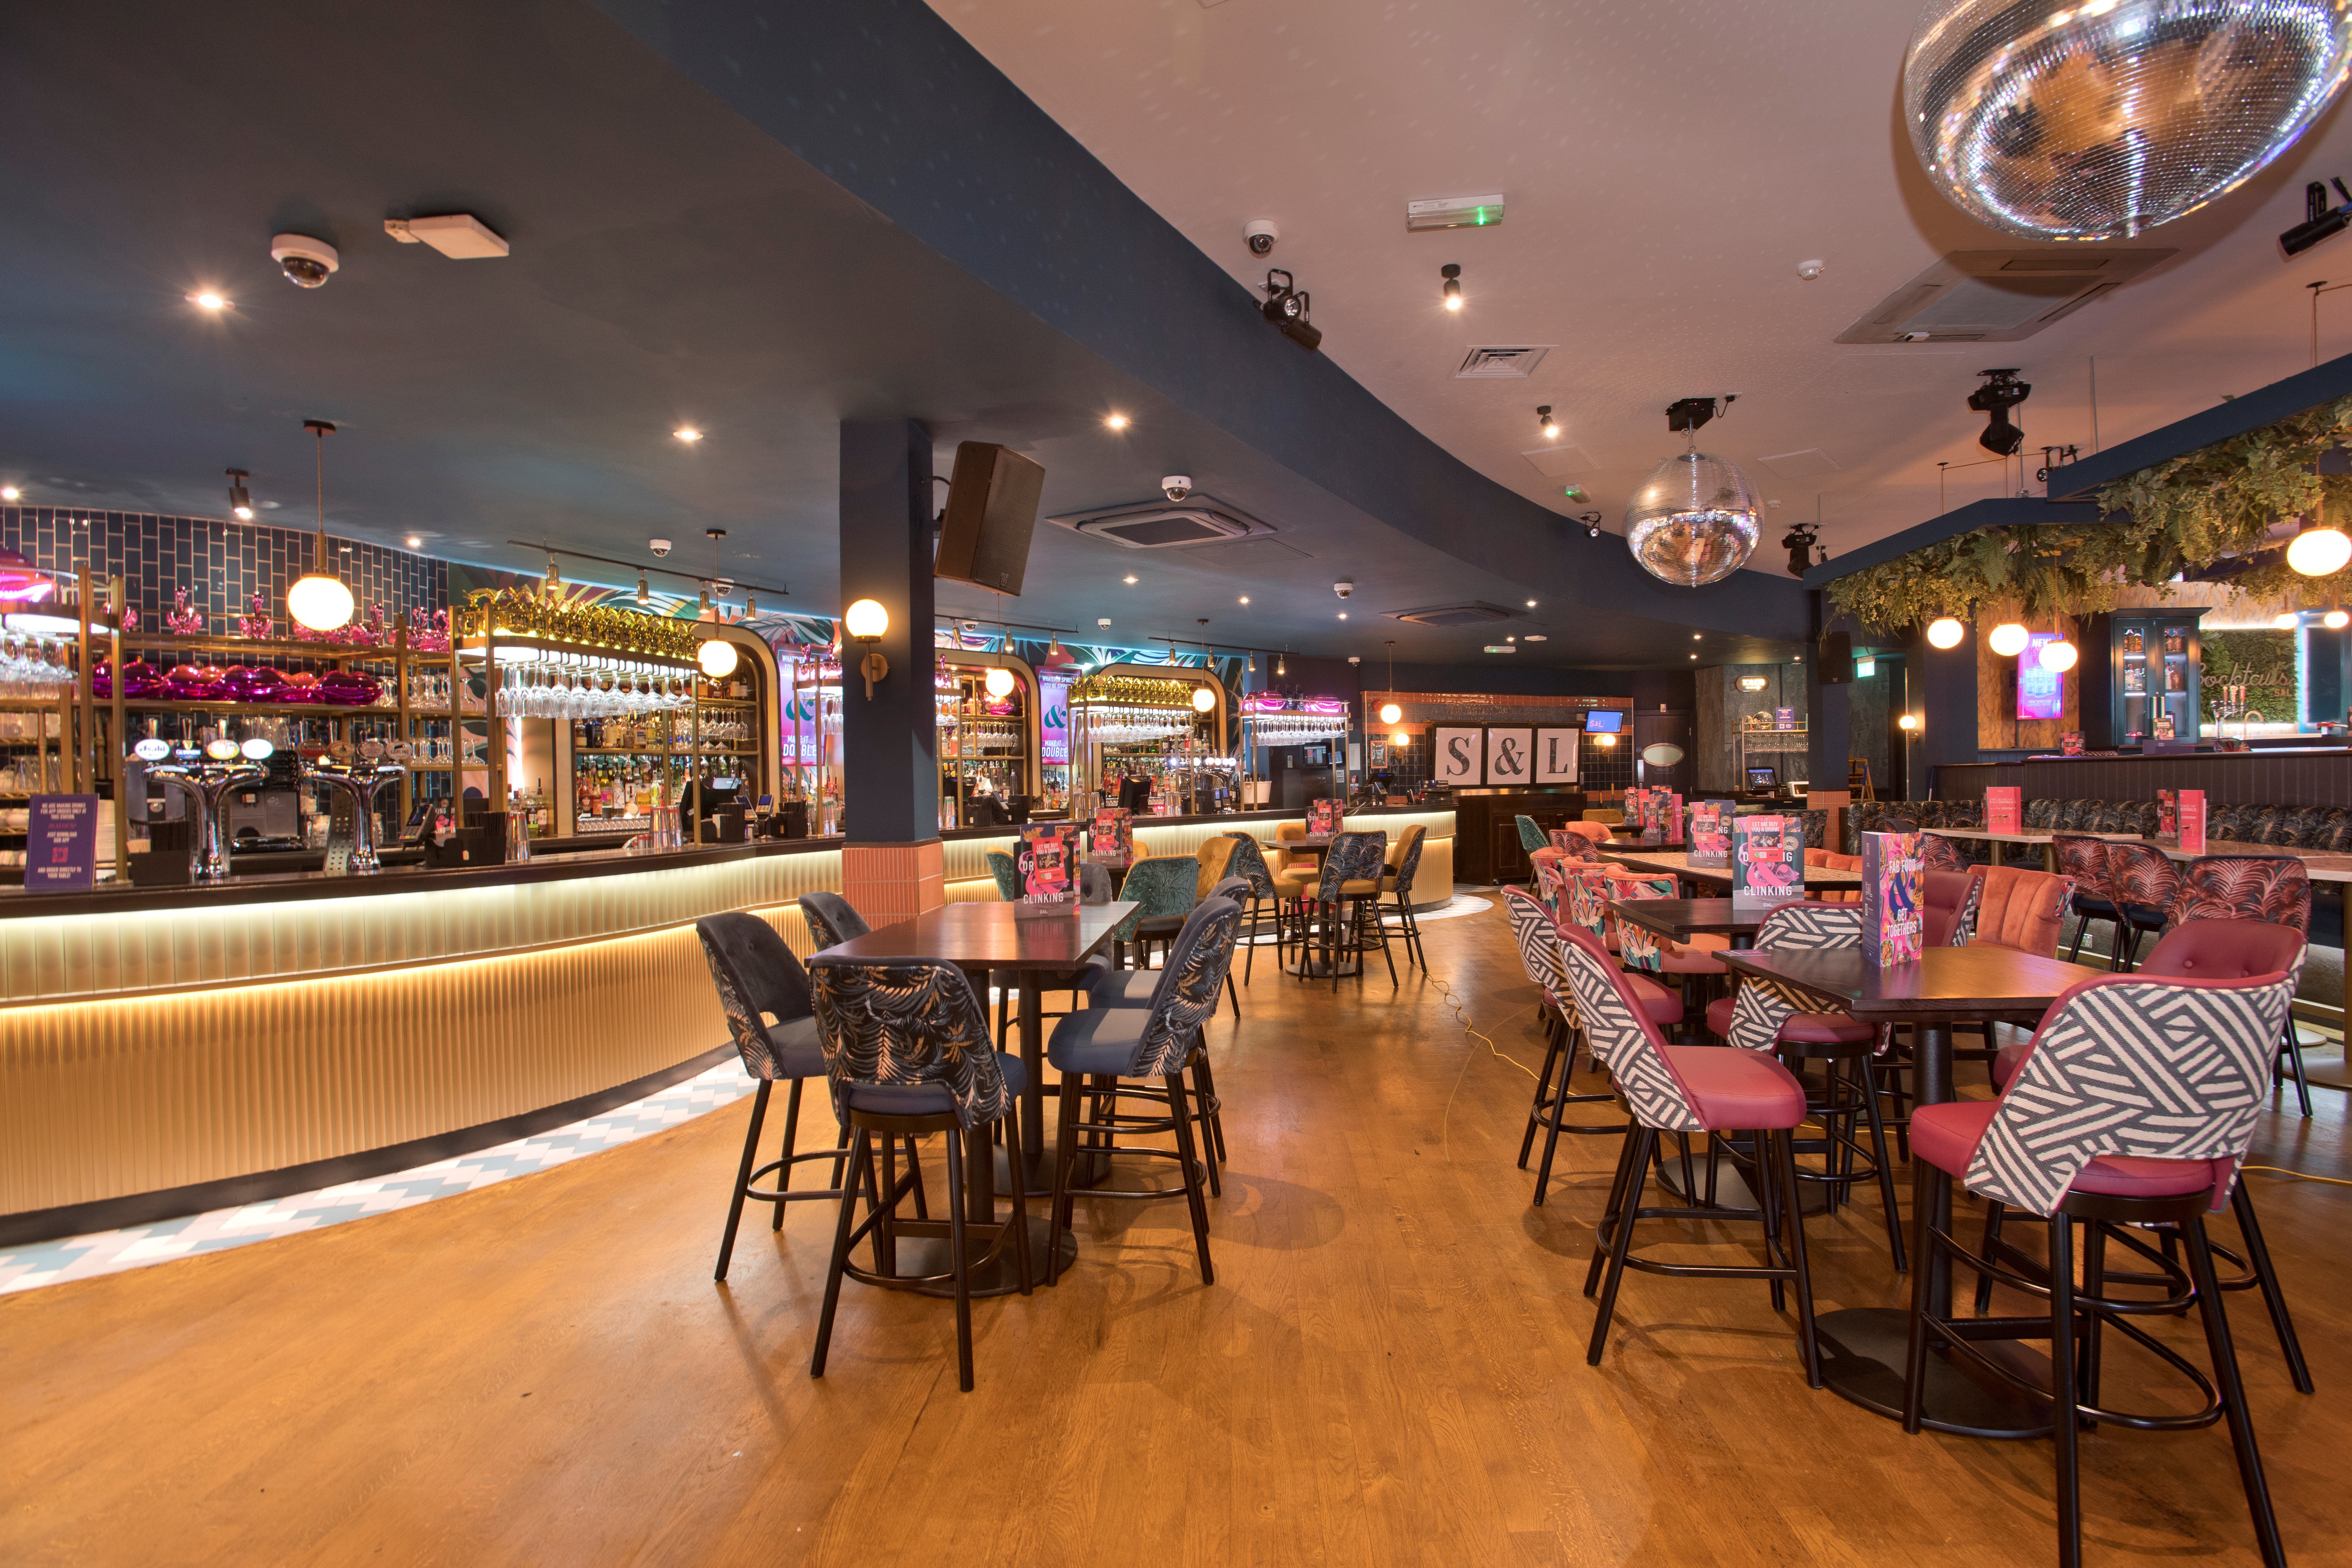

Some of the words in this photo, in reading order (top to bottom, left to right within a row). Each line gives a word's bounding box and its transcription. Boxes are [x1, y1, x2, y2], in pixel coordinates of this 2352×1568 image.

[2275, 688, 2293, 697] S&L
[1044, 704, 1067, 728] &
[783, 744, 817, 756] DOBLE
[1447, 737, 1470, 776] S
[1495, 738, 1524, 775] &
[1547, 738, 1568, 774] L
[1889, 860, 1900, 874] FAB
[1901, 859, 1916, 871] FOOD
[1744, 886, 1792, 896] CLINKING
[1023, 892, 1064, 904] CLINKING
[1897, 908, 1908, 921] GET
[1887, 921, 1917, 938] TOGETHERS
